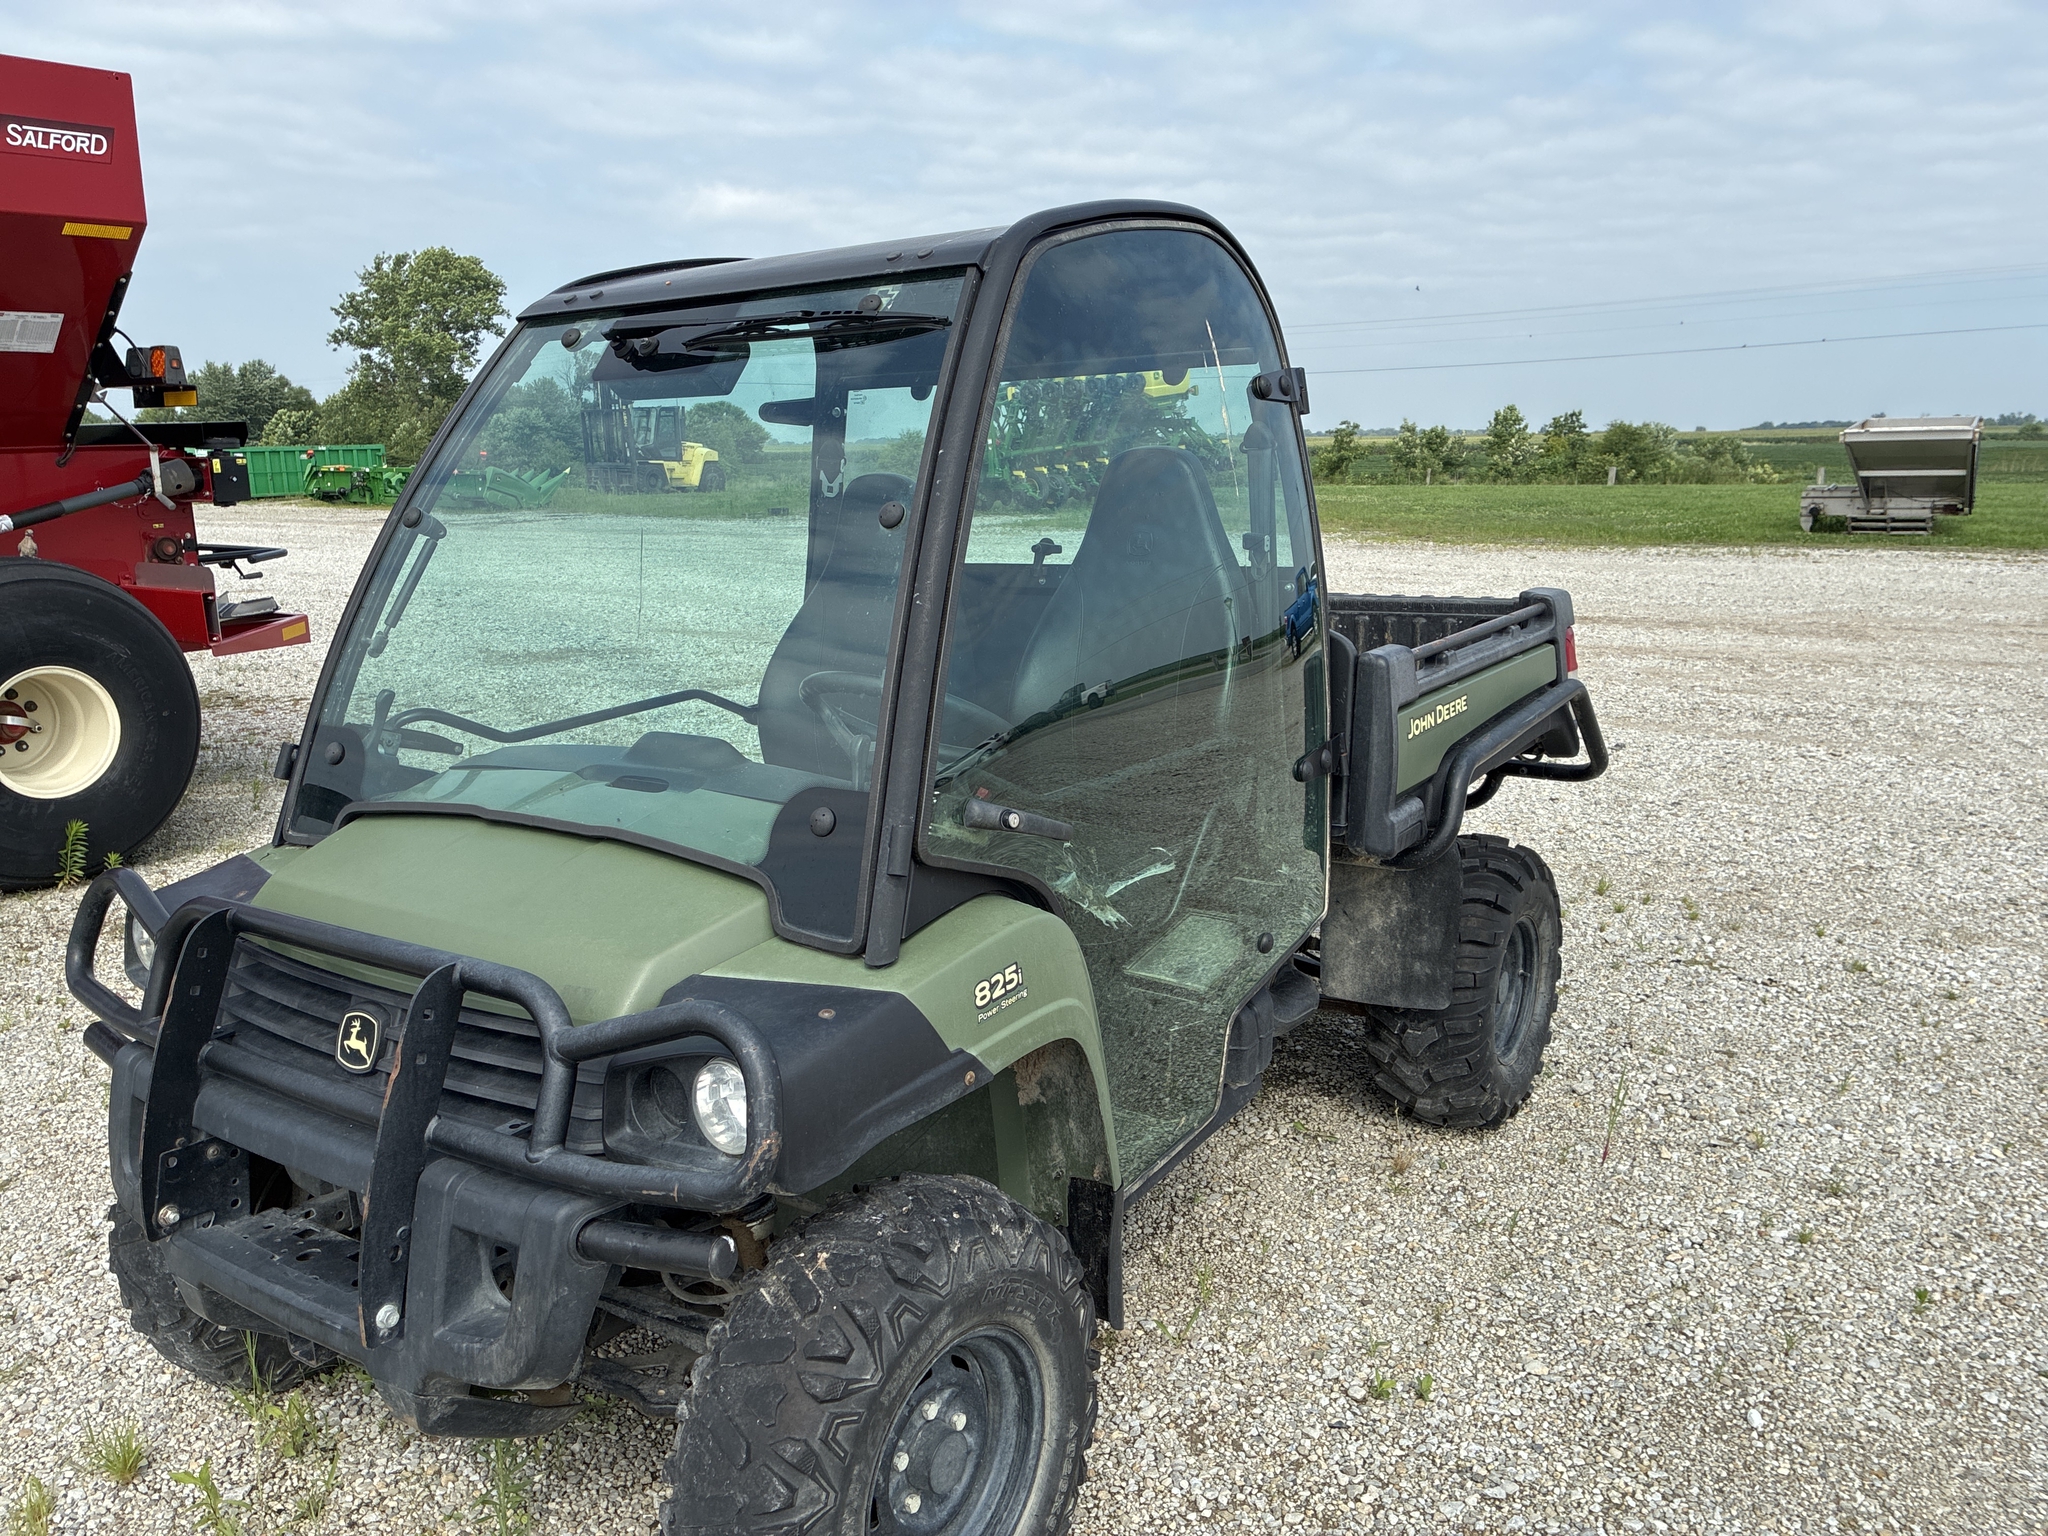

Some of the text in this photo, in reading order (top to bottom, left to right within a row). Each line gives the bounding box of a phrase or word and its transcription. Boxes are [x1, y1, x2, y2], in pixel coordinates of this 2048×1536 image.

[6, 124, 108, 155] SALFORD
[1408, 695, 1468, 740] JOHN DEERE
[974, 962, 1023, 1009] 825i
[977, 988, 1028, 1024] Power Steering
